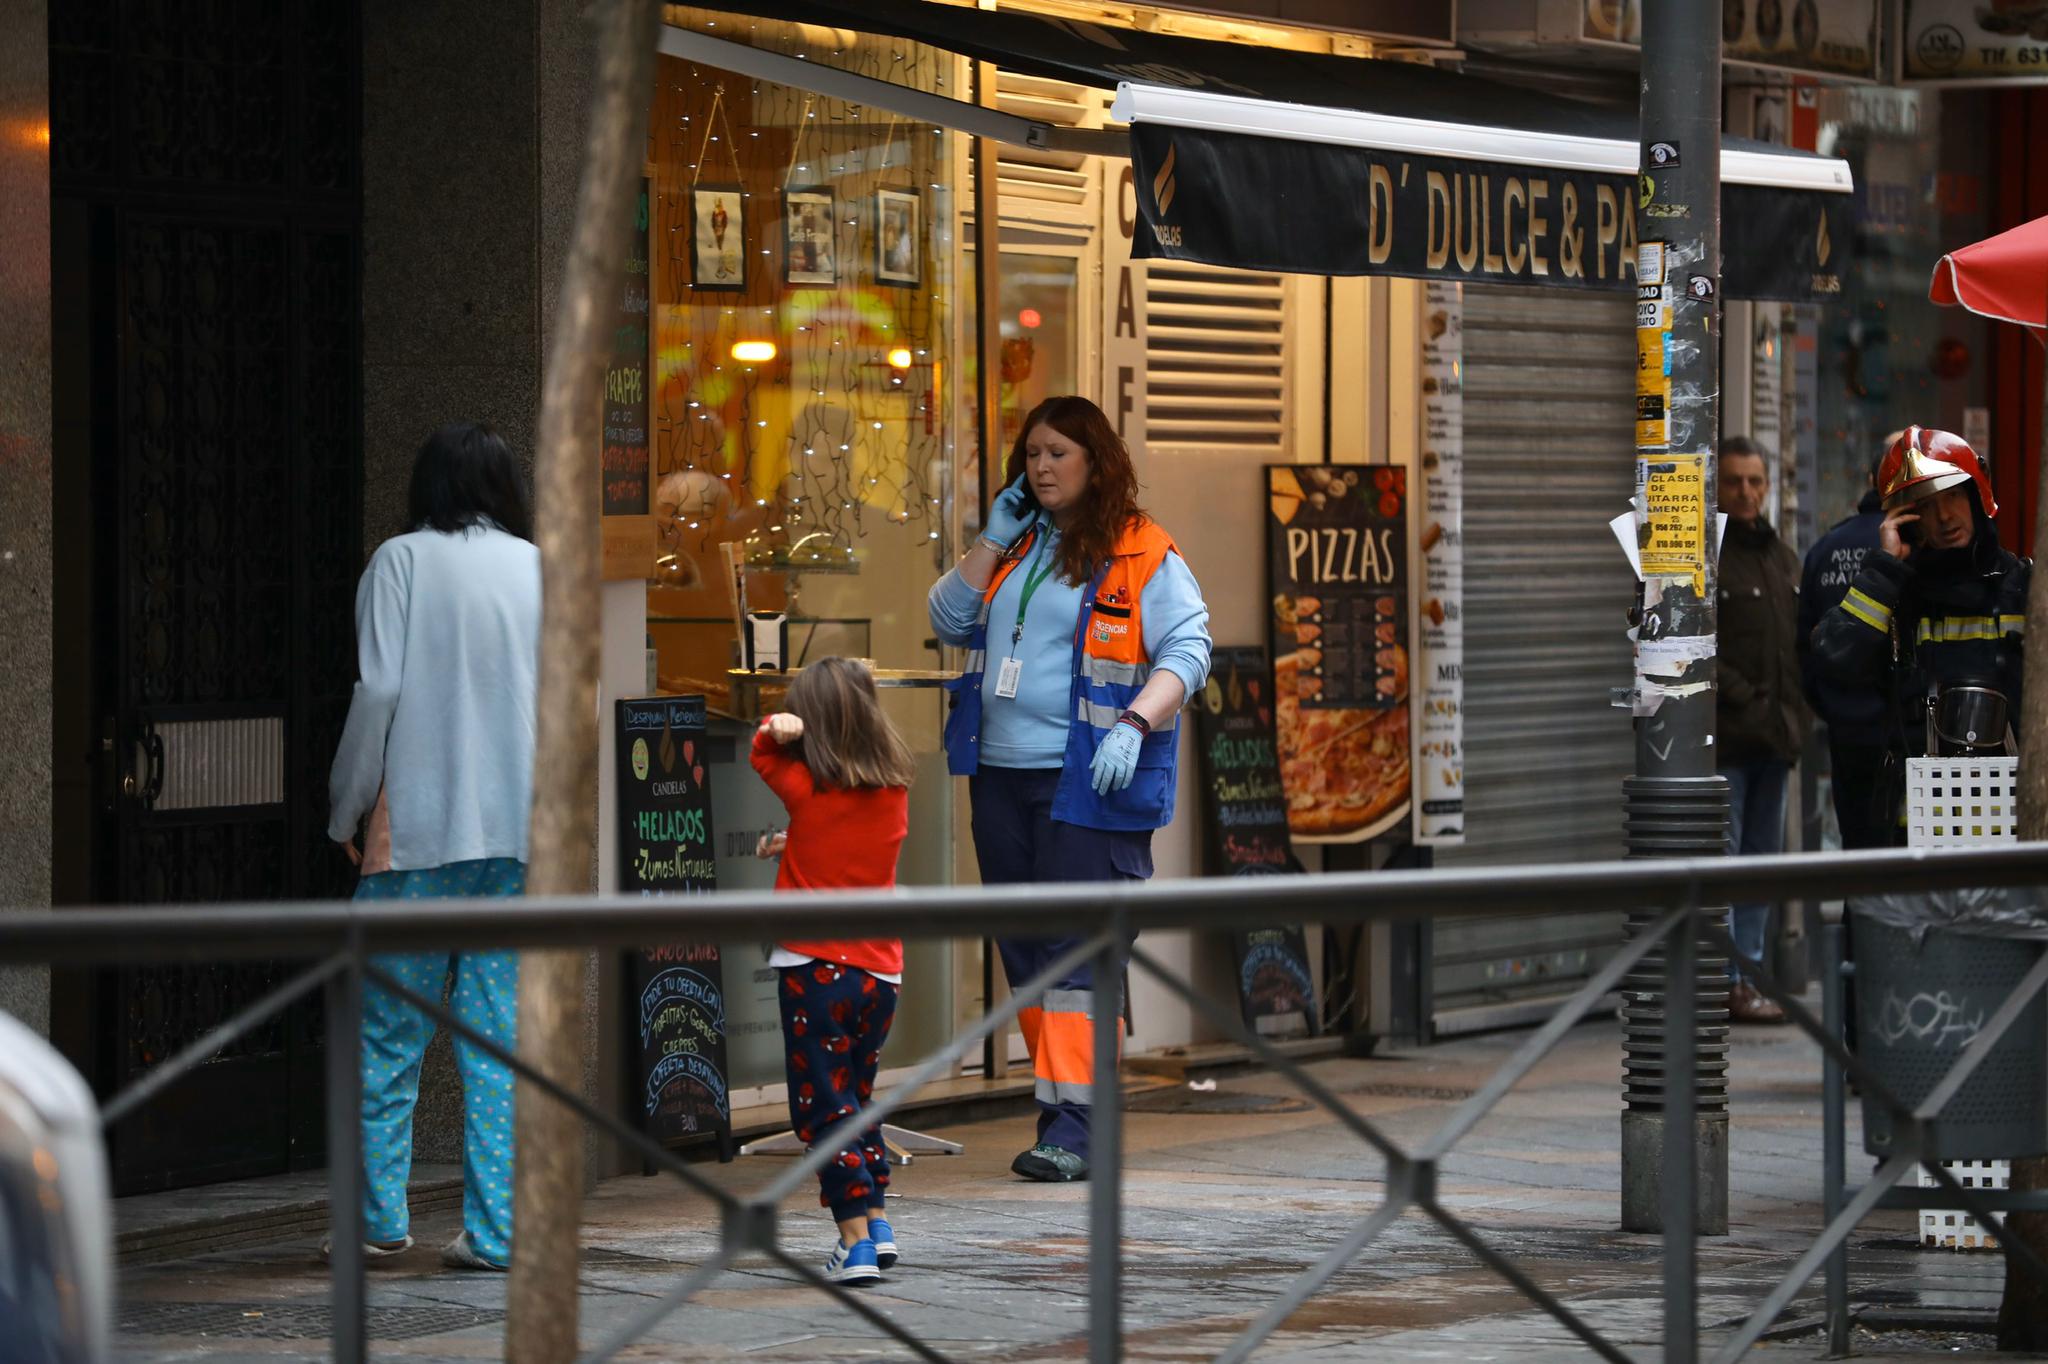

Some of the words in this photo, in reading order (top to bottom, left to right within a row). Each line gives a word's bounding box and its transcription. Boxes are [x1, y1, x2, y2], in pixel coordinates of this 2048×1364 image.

[1426, 170, 1550, 276] DULCE
[1560, 181, 1585, 278] &
[1651, 475, 1699, 483] CLASES
[1287, 528, 1395, 584] PIZZAS
[652, 781, 687, 796] CANDELAS
[639, 808, 705, 845] HELADOS
[664, 977, 676, 991] TU
